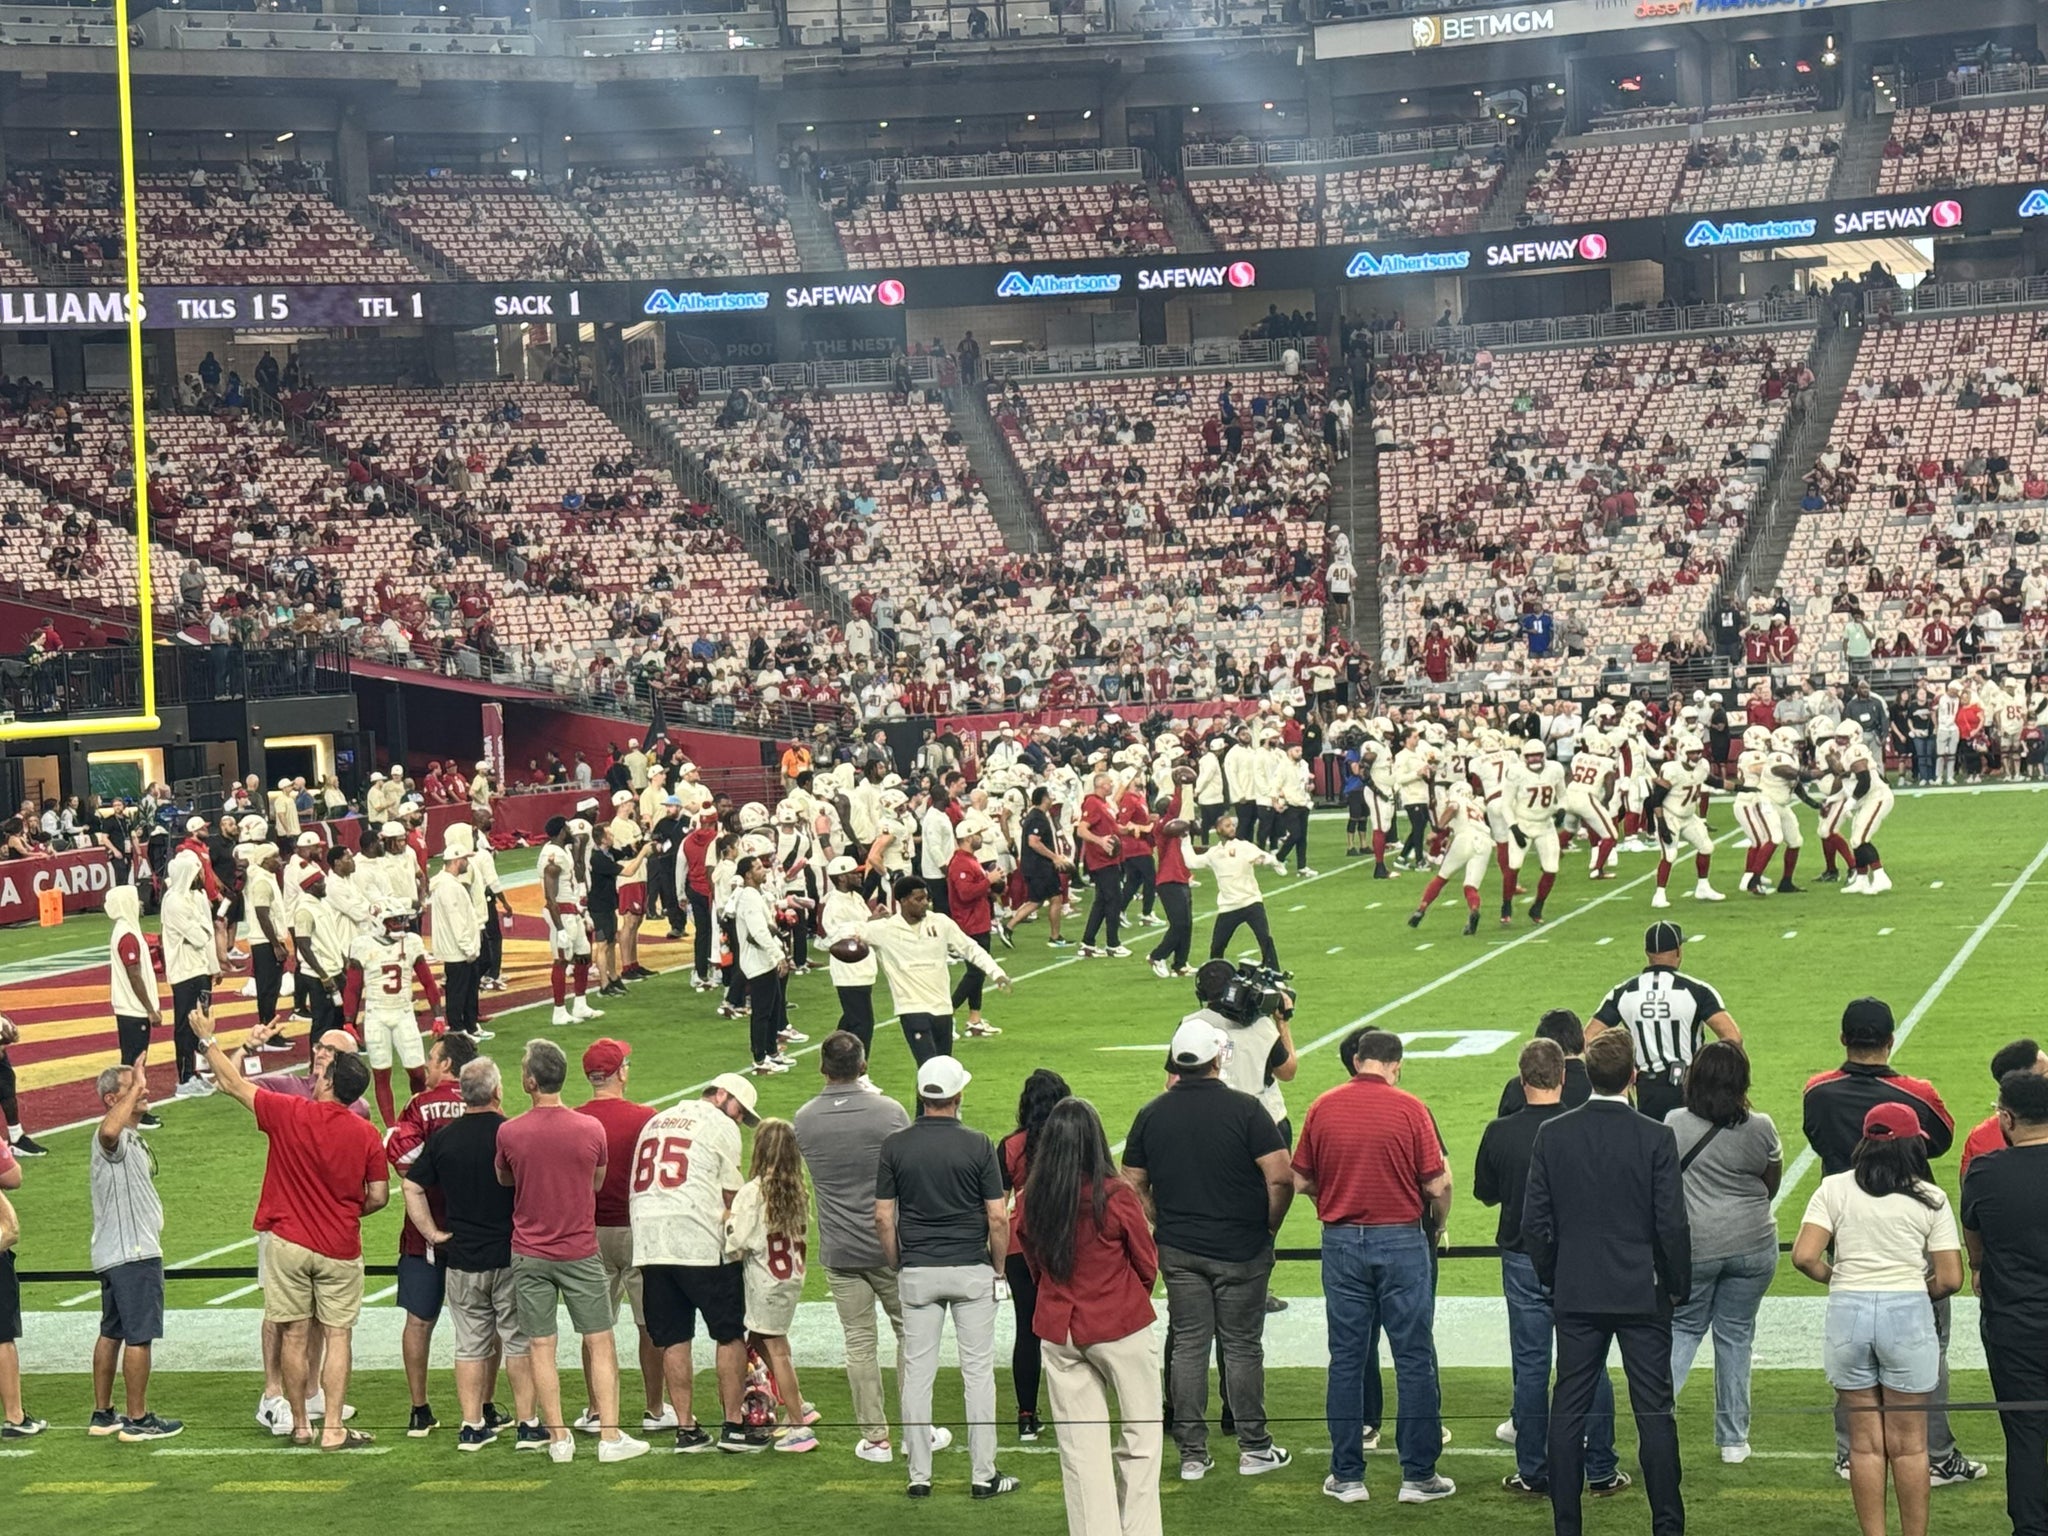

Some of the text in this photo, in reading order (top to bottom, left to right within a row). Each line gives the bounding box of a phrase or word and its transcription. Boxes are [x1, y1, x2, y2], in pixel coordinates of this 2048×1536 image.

[1443, 9, 1554, 40] BETMGM
[1721, 218, 1817, 243] Albertsons
[1834, 205, 1932, 235] SAFEWAY
[1379, 251, 1471, 274] Albertsons
[1486, 238, 1579, 266] SAFEWAY
[1031, 273, 1122, 295] Albertsons
[1138, 266, 1228, 290] SAFEWAY
[177, 298, 238, 319] TKLS
[252, 293, 289, 320] 15
[358, 297, 399, 318] TFL
[411, 292, 423, 318] 1
[494, 295, 554, 316] SACK
[569, 290, 580, 316] 1
[678, 284, 877, 313] Albertsons SAFEWAY
[1332, 567, 1348, 581] 40
[1527, 785, 1553, 809] 78
[381, 963, 403, 995] 3
[1640, 1001, 1671, 1019] 63
[633, 1136, 693, 1194] 85
